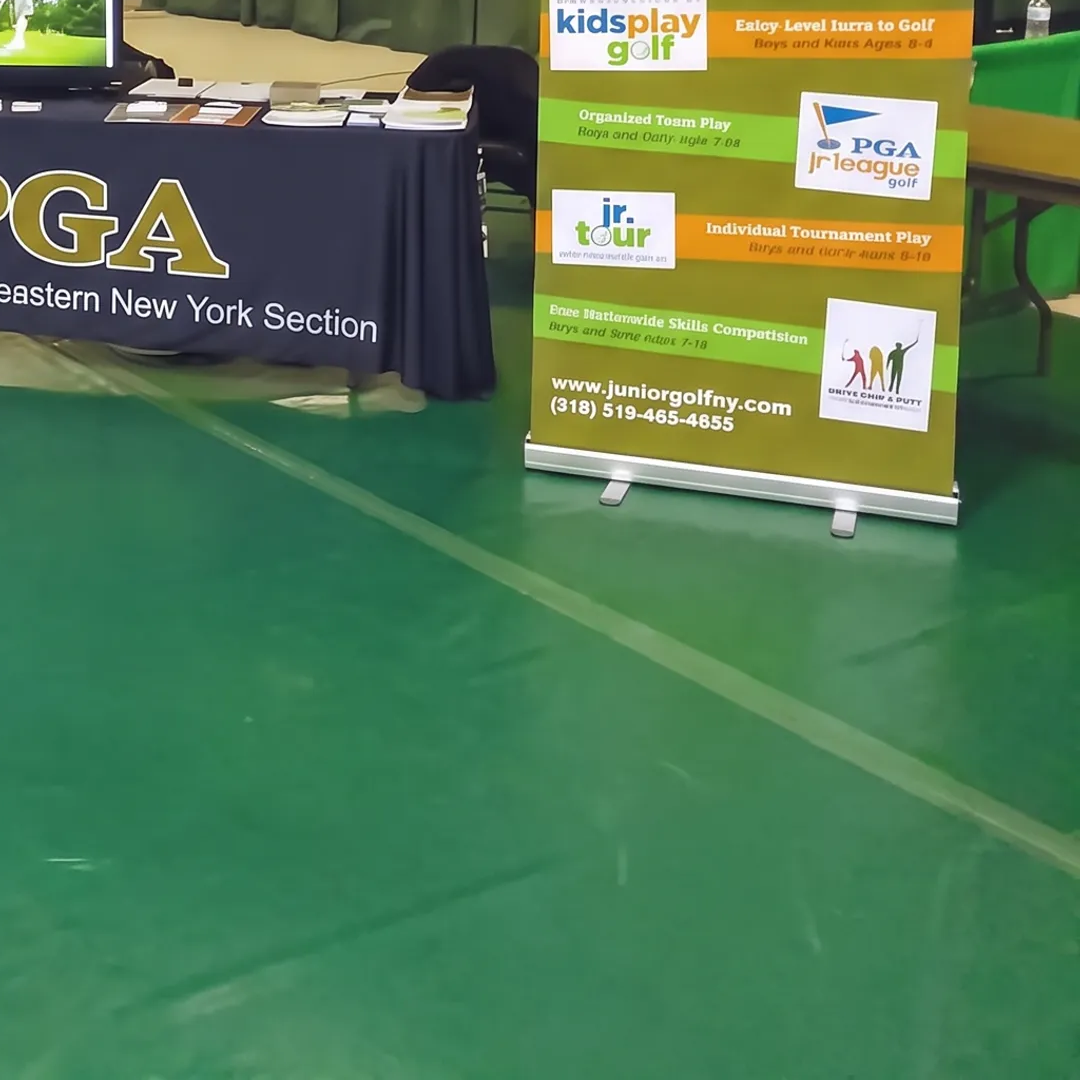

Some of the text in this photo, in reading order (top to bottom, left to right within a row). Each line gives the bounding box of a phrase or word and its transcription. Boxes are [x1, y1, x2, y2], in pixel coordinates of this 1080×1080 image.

[556, 8, 701, 39] kidsplay
[784, 18, 826, 32] Level
[877, 19, 895, 32] to
[898, 18, 936, 32] Golf
[607, 34, 675, 66] golf
[792, 38, 820, 49] and
[579, 109, 652, 125] Organized
[699, 117, 731, 133] Play
[851, 137, 922, 159] PGA
[888, 177, 918, 189] golf
[575, 220, 651, 248] tour
[706, 222, 932, 247] Individual Tournament Play
[111, 287, 177, 321] New
[186, 294, 254, 328] York
[263, 302, 379, 343] Section
[668, 318, 709, 333] Skills
[550, 396, 597, 420] (318)
[551, 377, 792, 416] www.juniorgolfny.com
